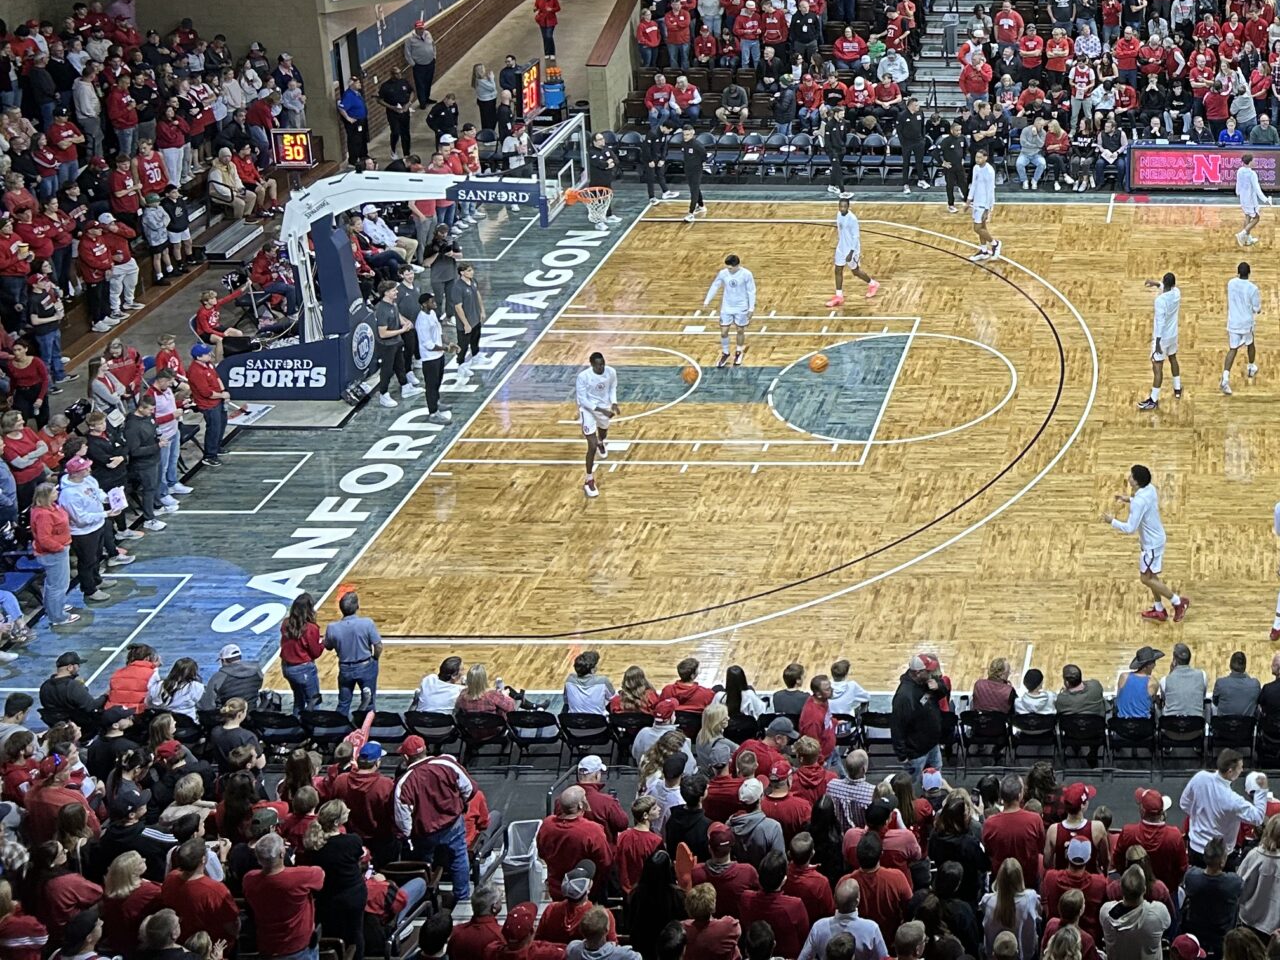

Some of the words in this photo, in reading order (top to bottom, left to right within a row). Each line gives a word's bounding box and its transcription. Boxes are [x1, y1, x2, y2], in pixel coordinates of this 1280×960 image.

[523, 65, 537, 88] 2:17
[522, 81, 536, 115] 30
[283, 146, 305, 162] 30
[146, 167, 162, 184] 30
[1192, 154, 1222, 184] N
[457, 189, 530, 204] SANFORD
[245, 358, 314, 370] SANFORD
[228, 366, 327, 388] SPORTS
